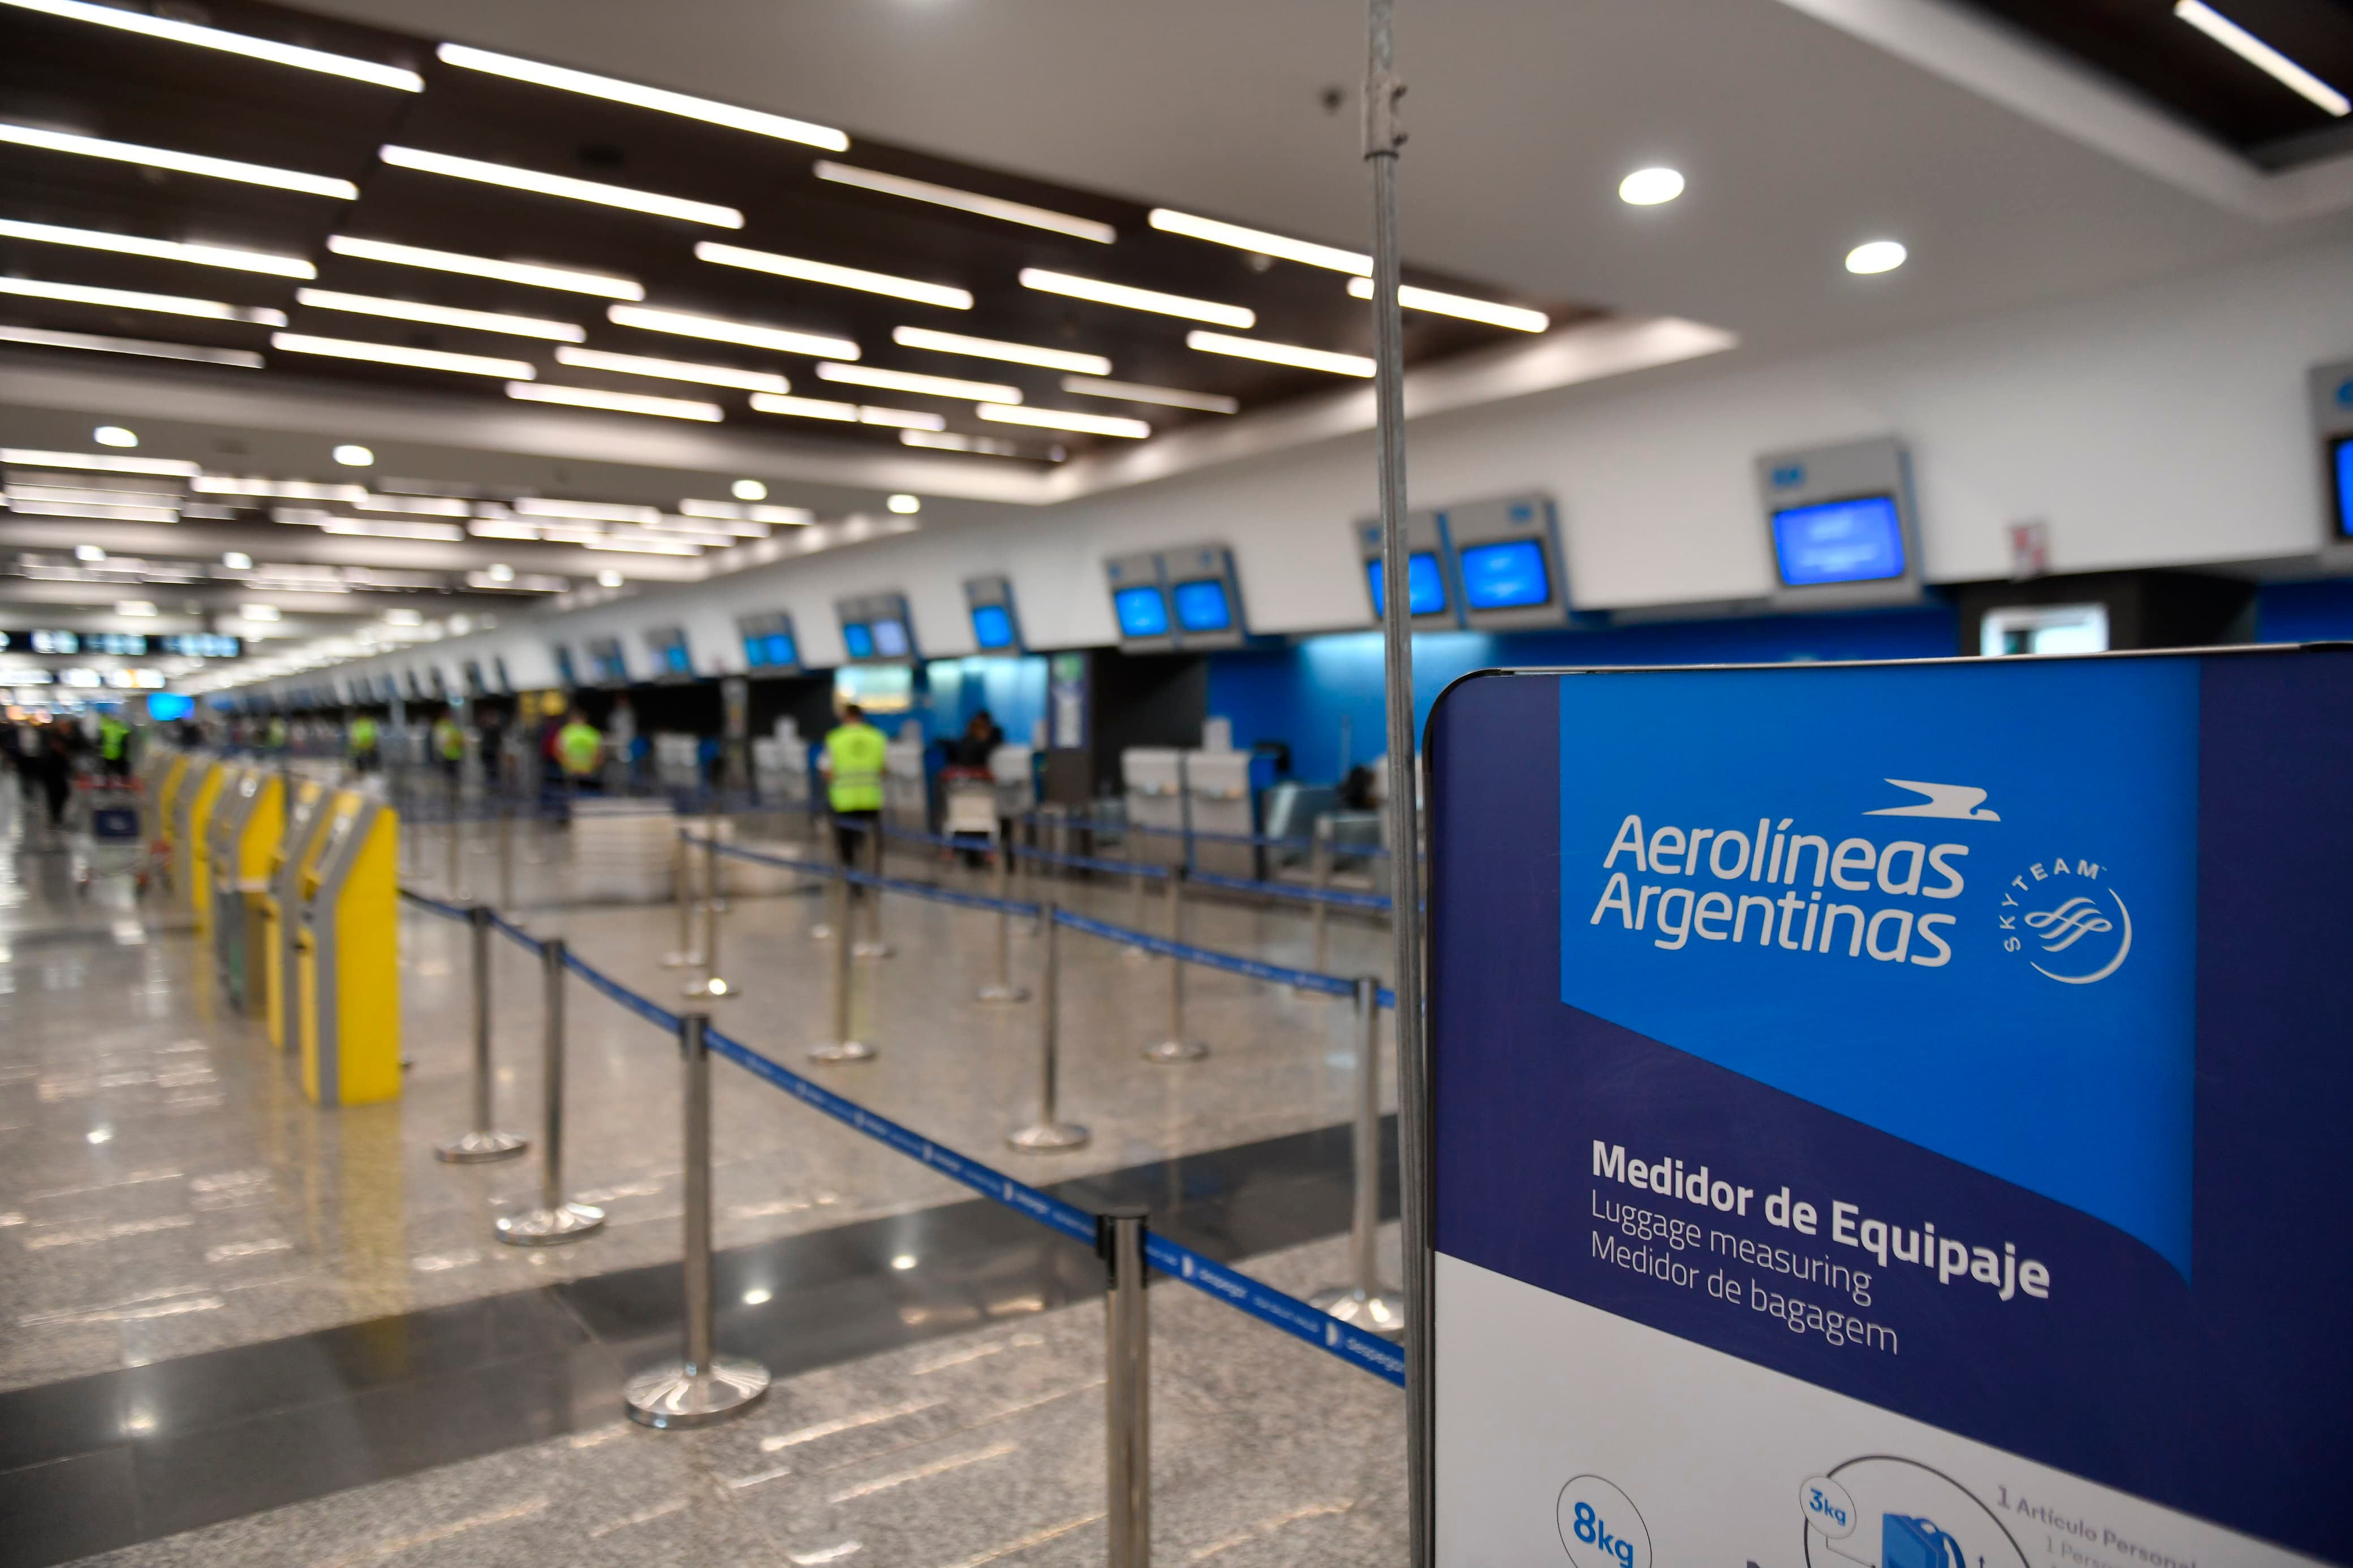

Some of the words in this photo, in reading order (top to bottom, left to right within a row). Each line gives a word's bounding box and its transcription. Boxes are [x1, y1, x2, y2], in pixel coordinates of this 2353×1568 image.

[1604, 814, 1969, 899] Aerolíneas
[1590, 872, 1956, 967] Argentinas
[1999, 857, 2100, 953] SKYTEAM
[1592, 1189, 1701, 1250] Luggage
[1710, 1230, 1872, 1307] measuring
[1593, 1139, 1753, 1217] Medidor
[1765, 1186, 1817, 1236] de
[1832, 1200, 2050, 1301] Equipaje
[1592, 1230, 1699, 1289] Medidor
[1708, 1268, 1741, 1304] de
[1751, 1278, 1897, 1355] bagagem
[1574, 1501, 1634, 1568] 8kg
[1809, 1488, 1847, 1527] 3kg
[1997, 1484, 2010, 1510] 1
